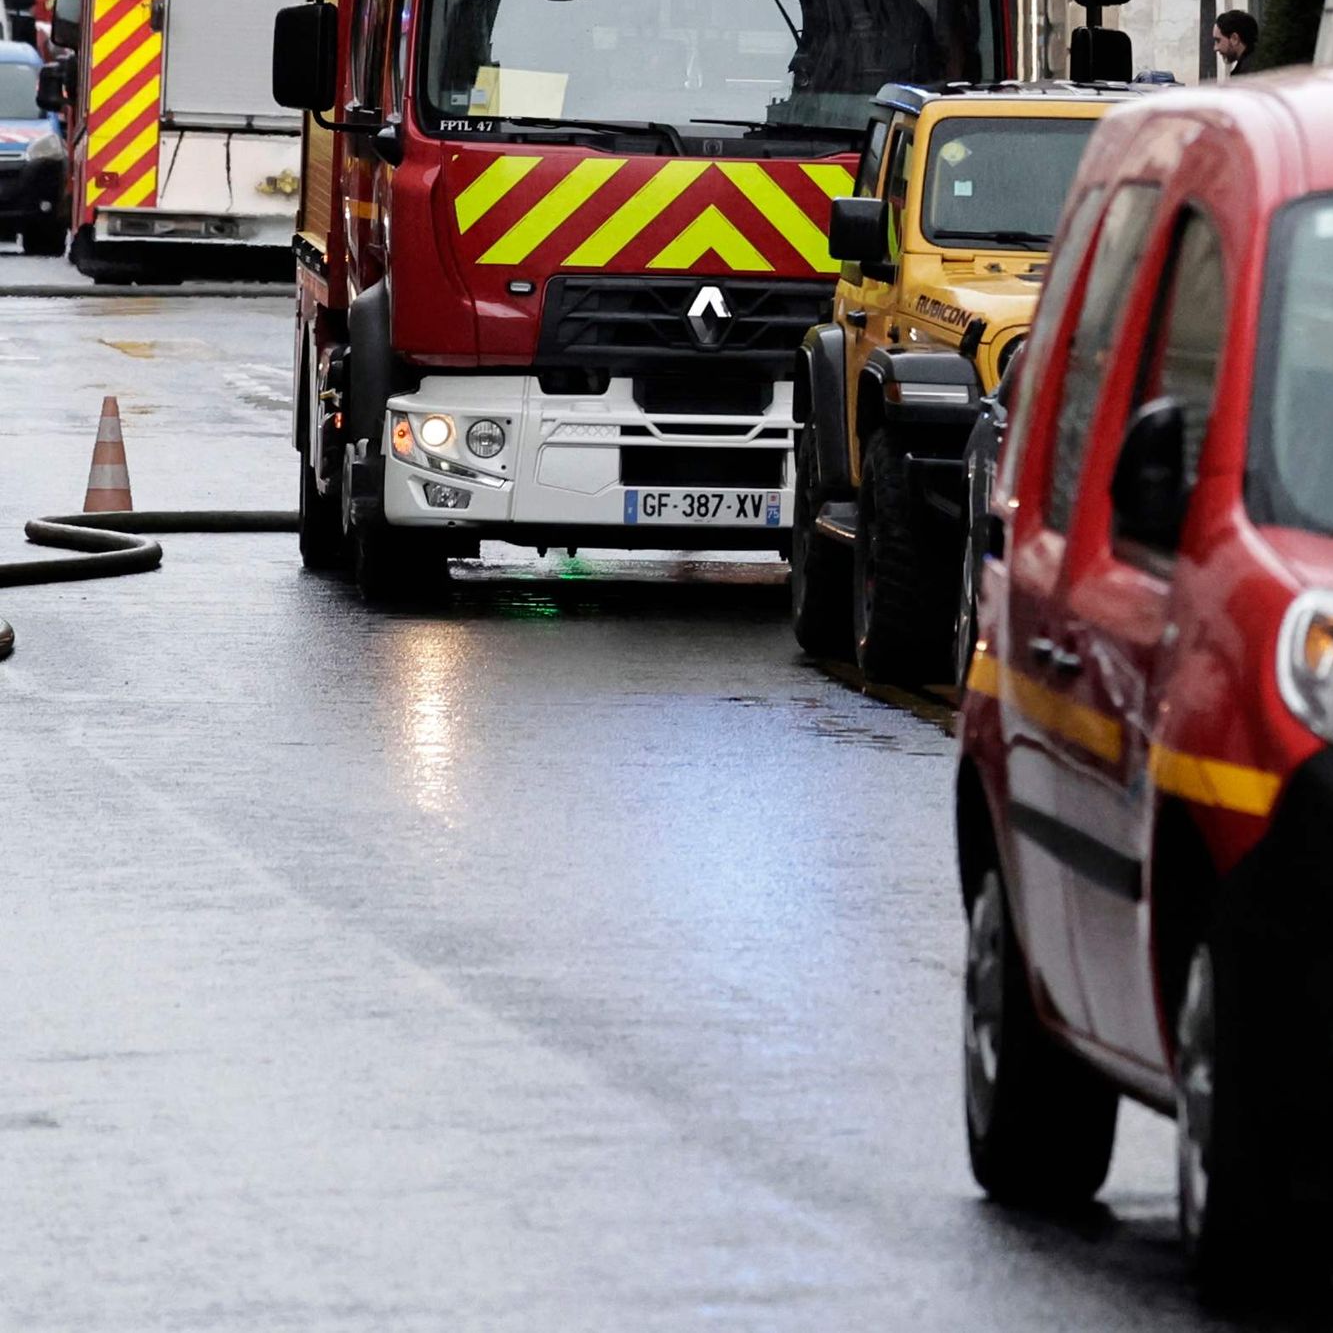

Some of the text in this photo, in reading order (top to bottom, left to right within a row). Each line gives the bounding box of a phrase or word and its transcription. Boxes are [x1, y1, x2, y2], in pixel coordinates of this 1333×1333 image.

[440, 120, 493, 131] FPTL 47
[915, 293, 972, 328] RUBICON
[643, 493, 763, 518] GF-387-XV
